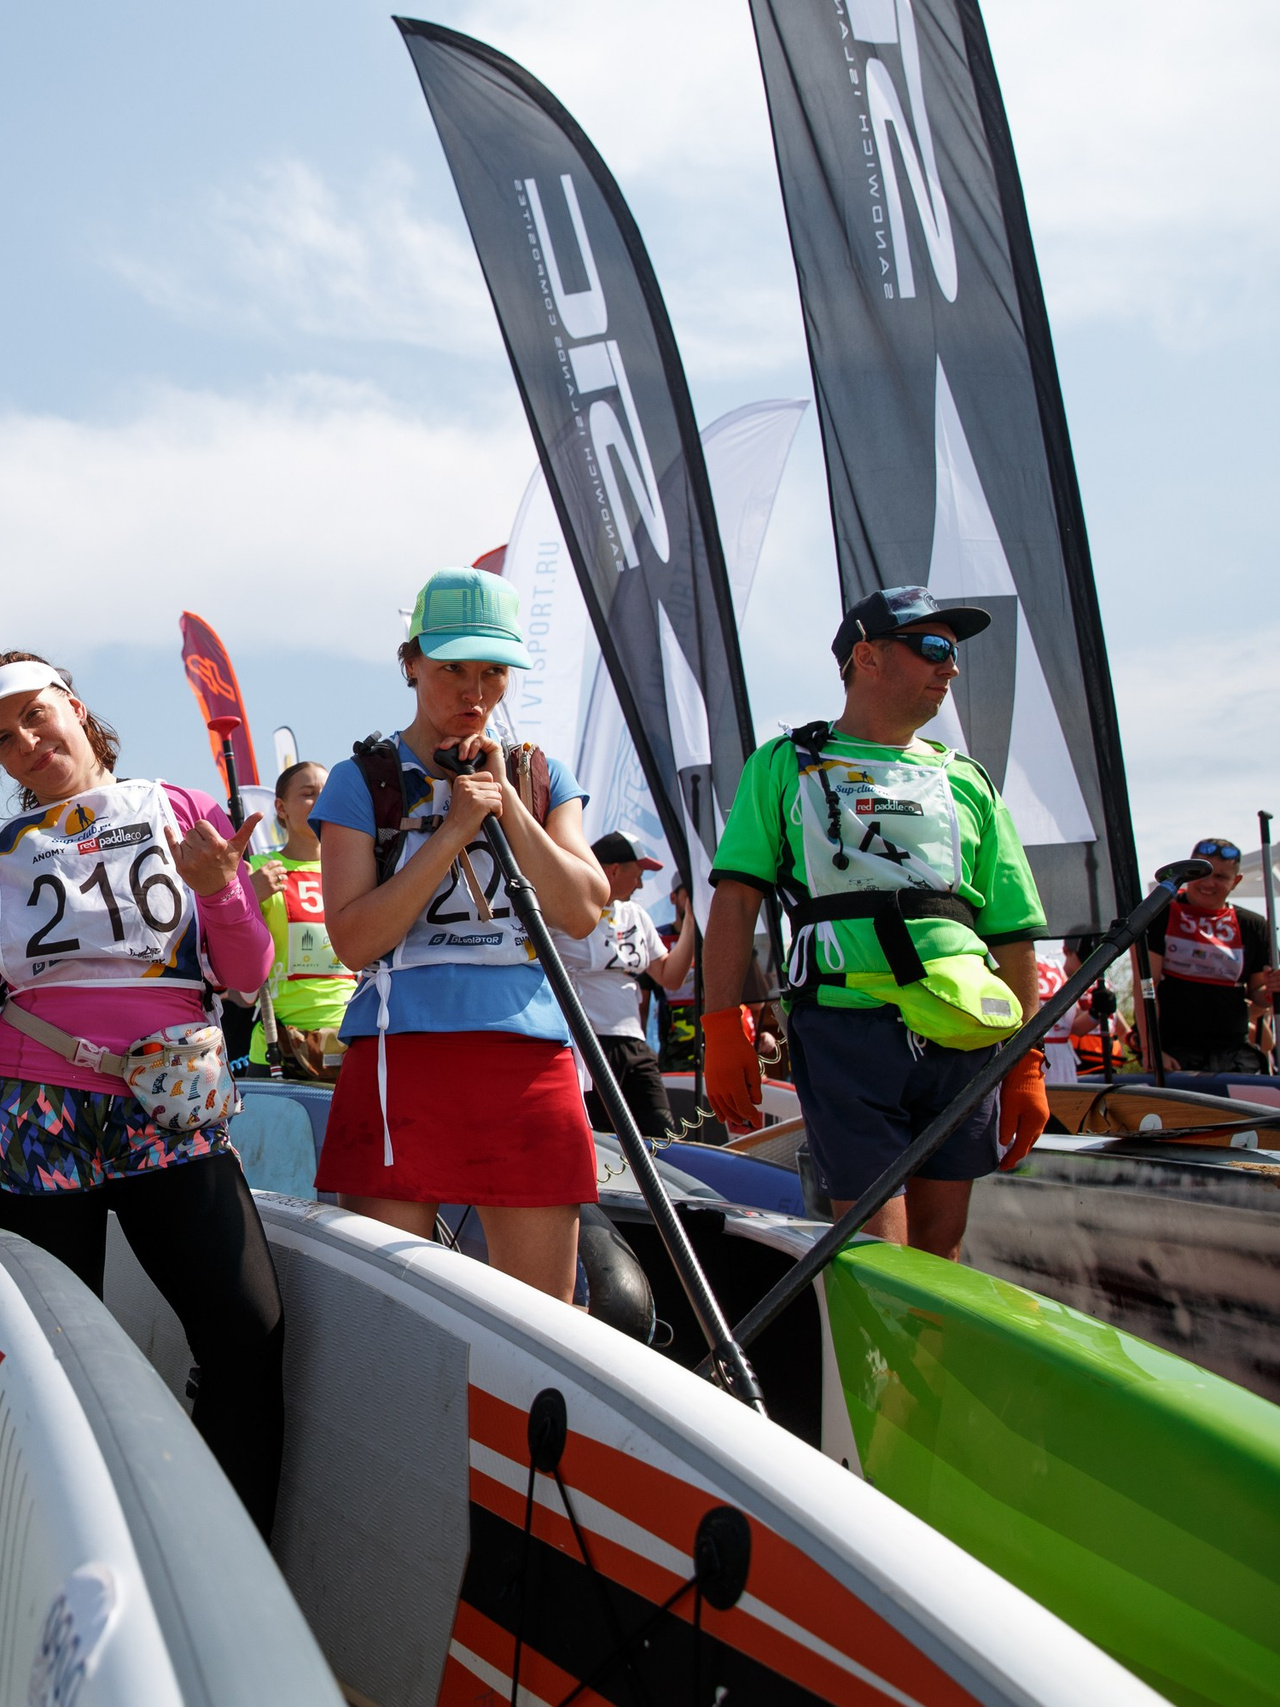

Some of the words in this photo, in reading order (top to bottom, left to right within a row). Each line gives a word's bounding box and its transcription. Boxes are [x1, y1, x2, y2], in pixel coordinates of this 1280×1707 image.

[857, 799, 871, 811] red
[32, 847, 66, 864] ANOMY
[79, 838, 98, 850] red
[858, 821, 911, 867] 4
[426, 840, 520, 925] 22
[26, 845, 182, 958] 216
[1179, 910, 1236, 943] 555
[603, 937, 644, 971] 23
